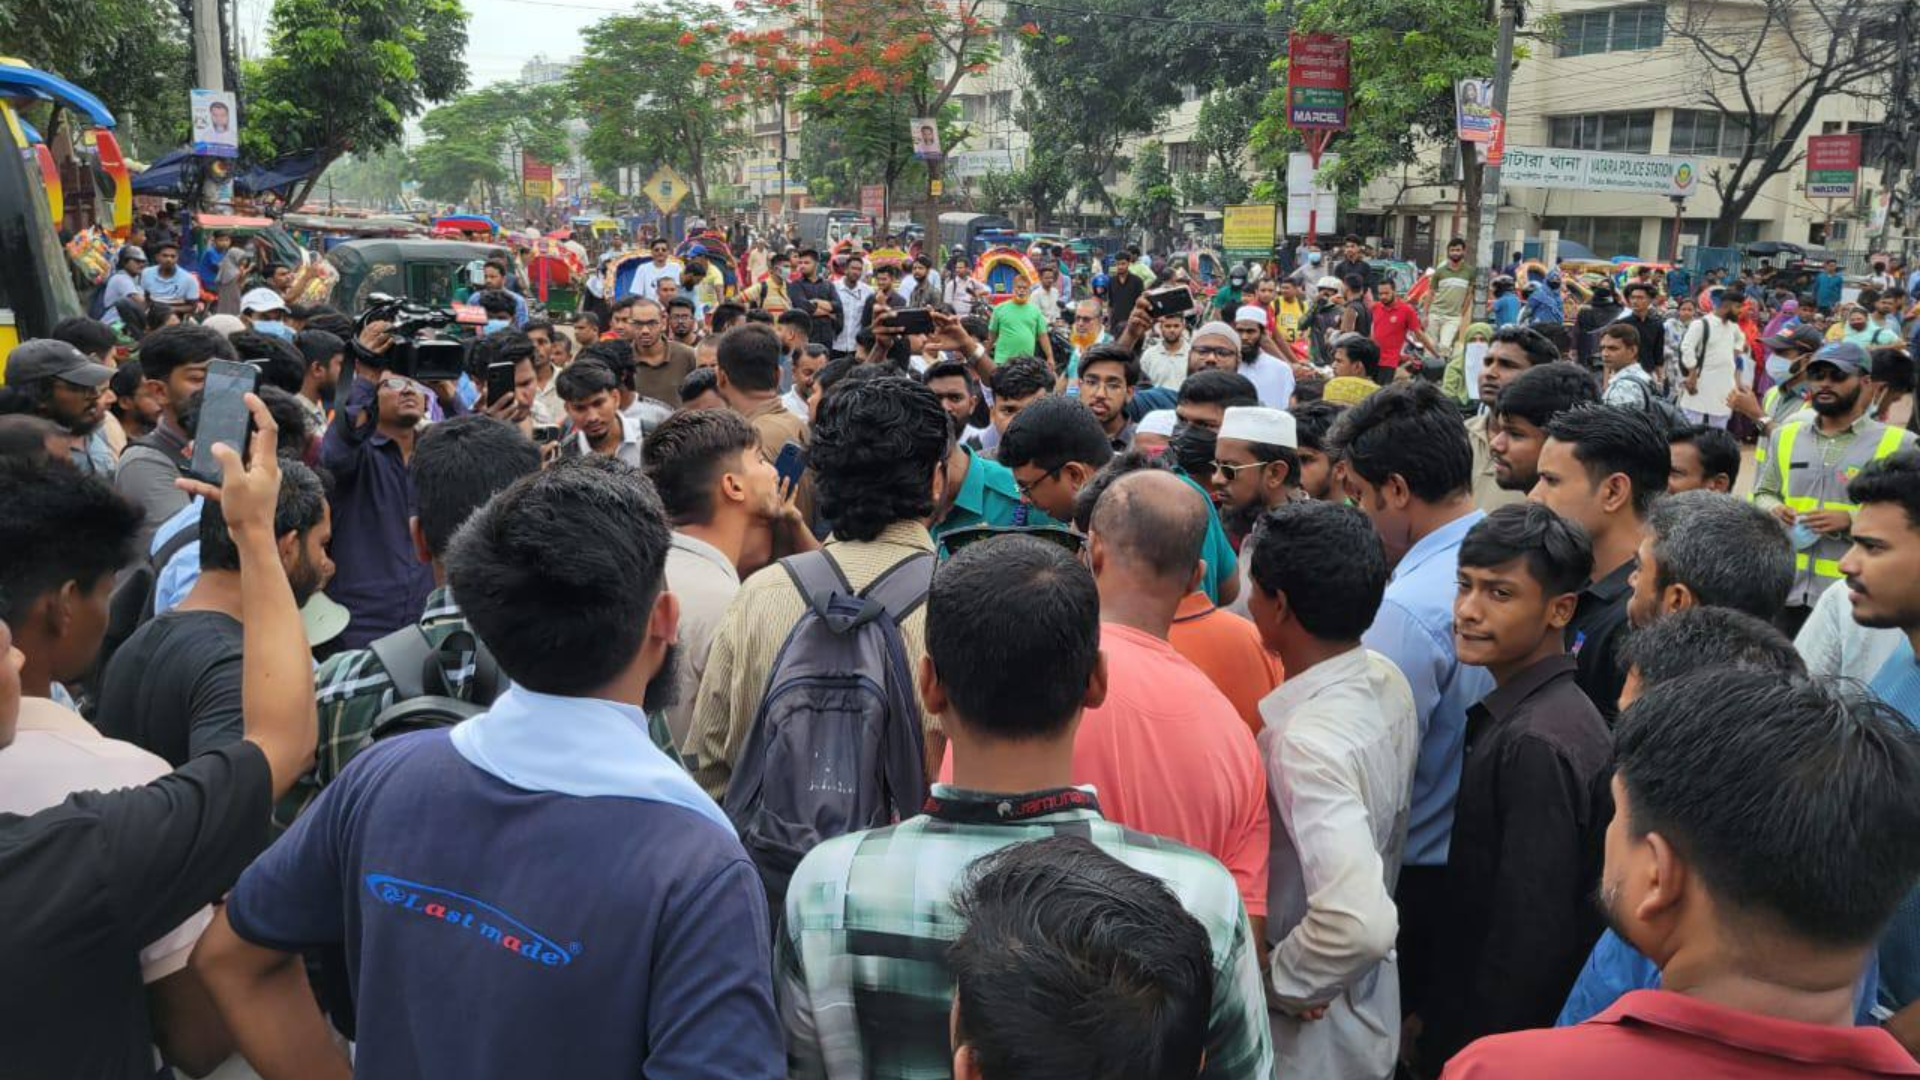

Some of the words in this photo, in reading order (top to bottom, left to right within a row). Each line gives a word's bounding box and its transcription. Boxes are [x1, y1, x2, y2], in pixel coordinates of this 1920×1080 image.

[1294, 110, 1340, 123] MARCEL
[1550, 154, 1582, 171] থানা
[1591, 157, 1618, 173] VATARA
[1619, 160, 1646, 177] POLICE
[1646, 161, 1673, 178] STATION
[1812, 185, 1850, 193] WALTON
